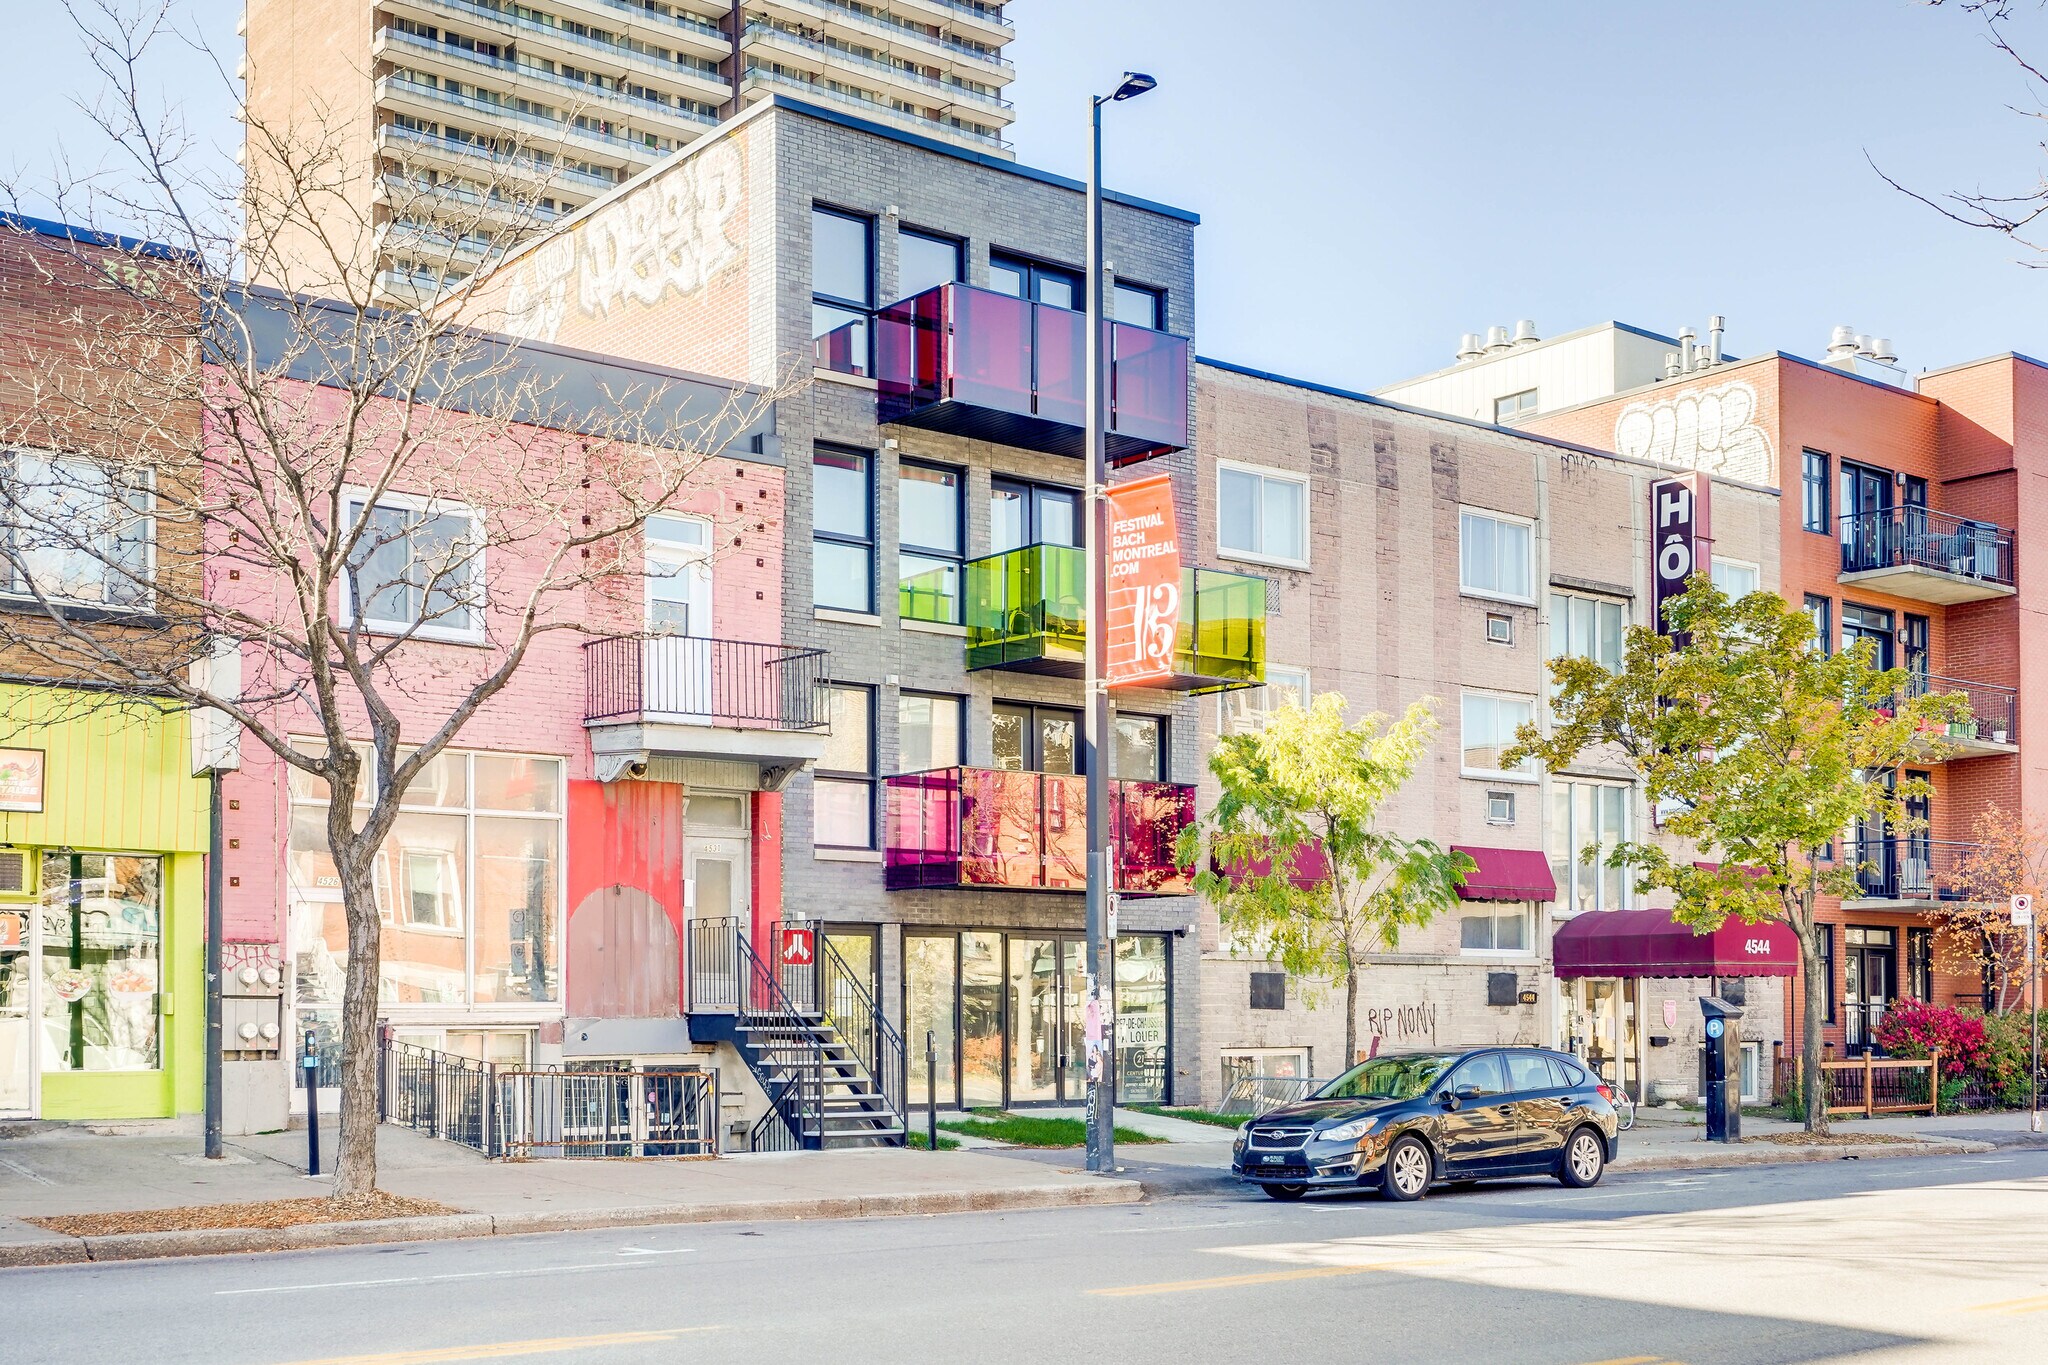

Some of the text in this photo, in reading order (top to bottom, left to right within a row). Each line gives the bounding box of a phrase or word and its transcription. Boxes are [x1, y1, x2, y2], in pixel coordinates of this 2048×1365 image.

[1113, 512, 1164, 534] FESTIVAL
[1113, 532, 1146, 547] BACH
[1112, 541, 1177, 563] MONTREAL
[1111, 560, 1140, 578] .COM
[318, 877, 339, 886] 4526
[1745, 938, 1771, 955] 4544
[1368, 1007, 1393, 1038] RIP
[1130, 1030, 1159, 1043] LOUER
